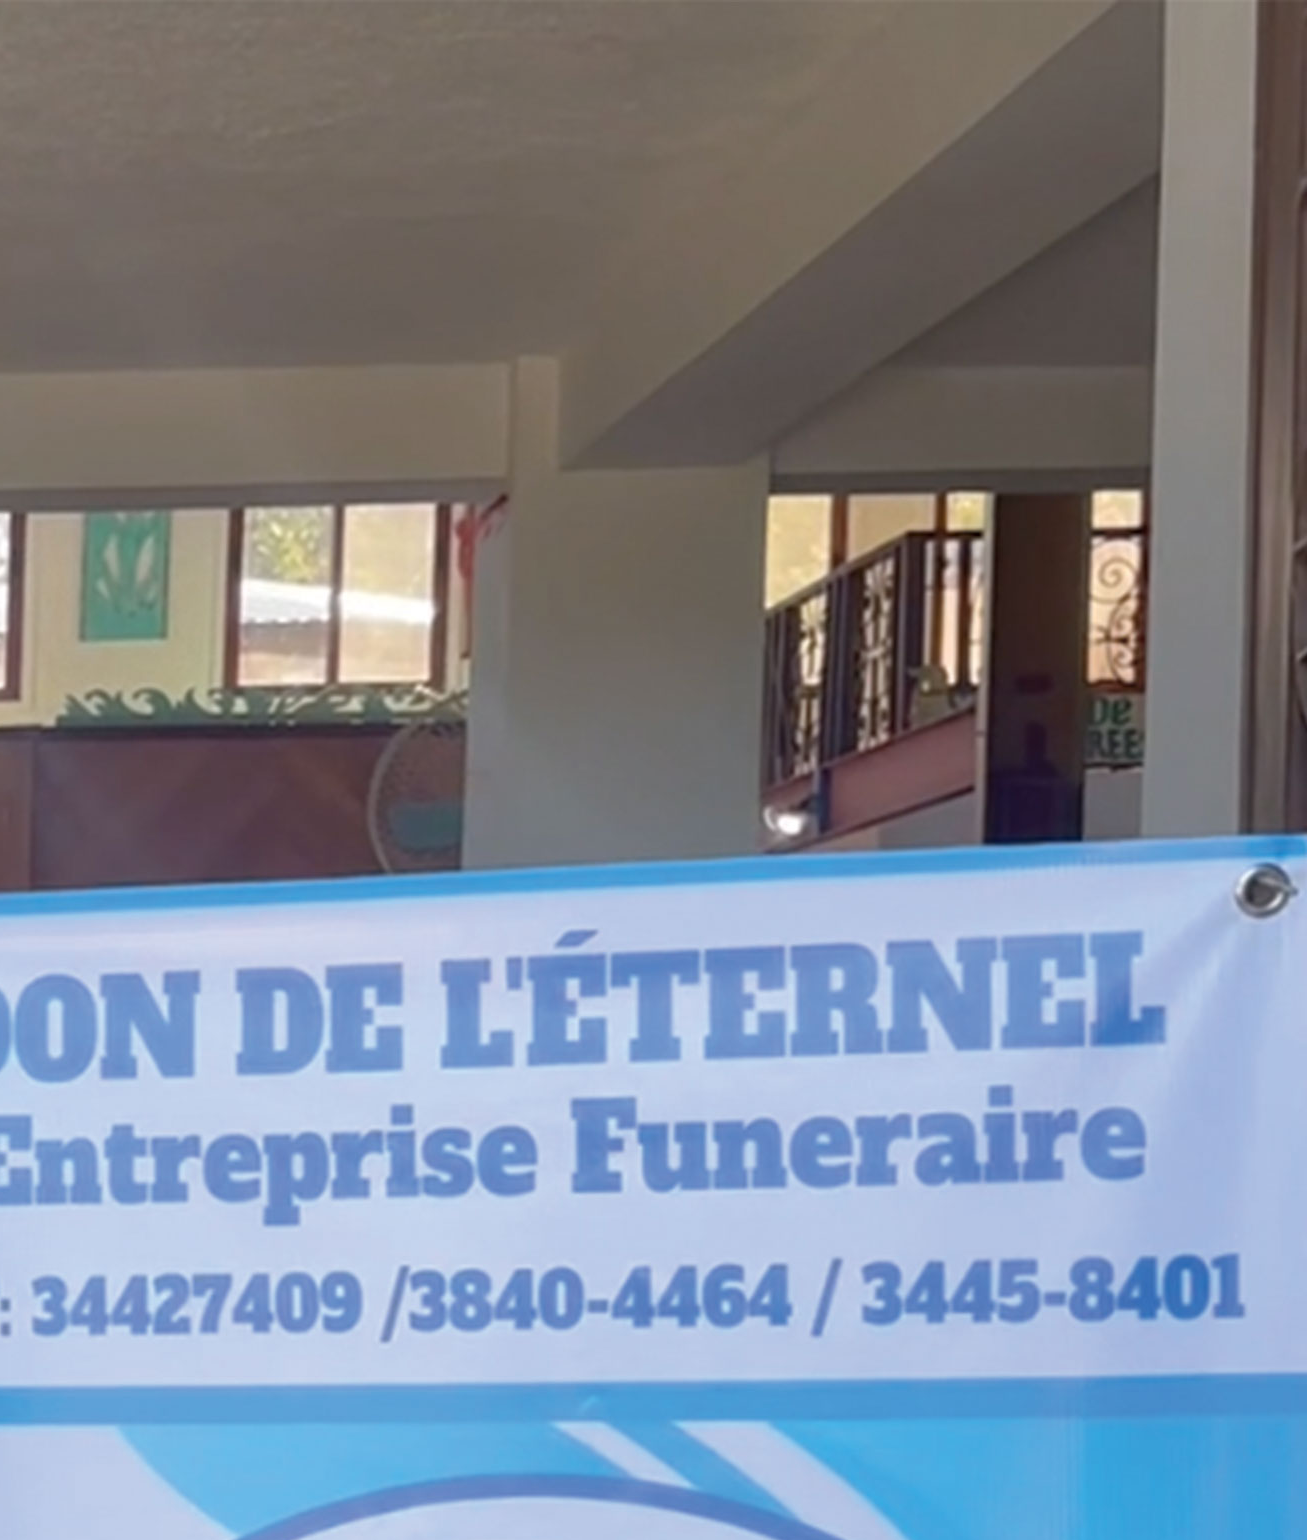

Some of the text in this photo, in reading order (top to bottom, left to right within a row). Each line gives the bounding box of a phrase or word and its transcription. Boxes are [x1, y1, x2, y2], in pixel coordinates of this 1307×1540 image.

[233, 962, 404, 1076] DE
[439, 930, 1167, 1070] L'ÉTERNEL
[569, 1086, 1147, 1195] Funeraire
[31, 1270, 363, 1336] 34427409
[381, 1262, 792, 1342] /3840-4464
[860, 1253, 1245, 1328] 3445-8401
